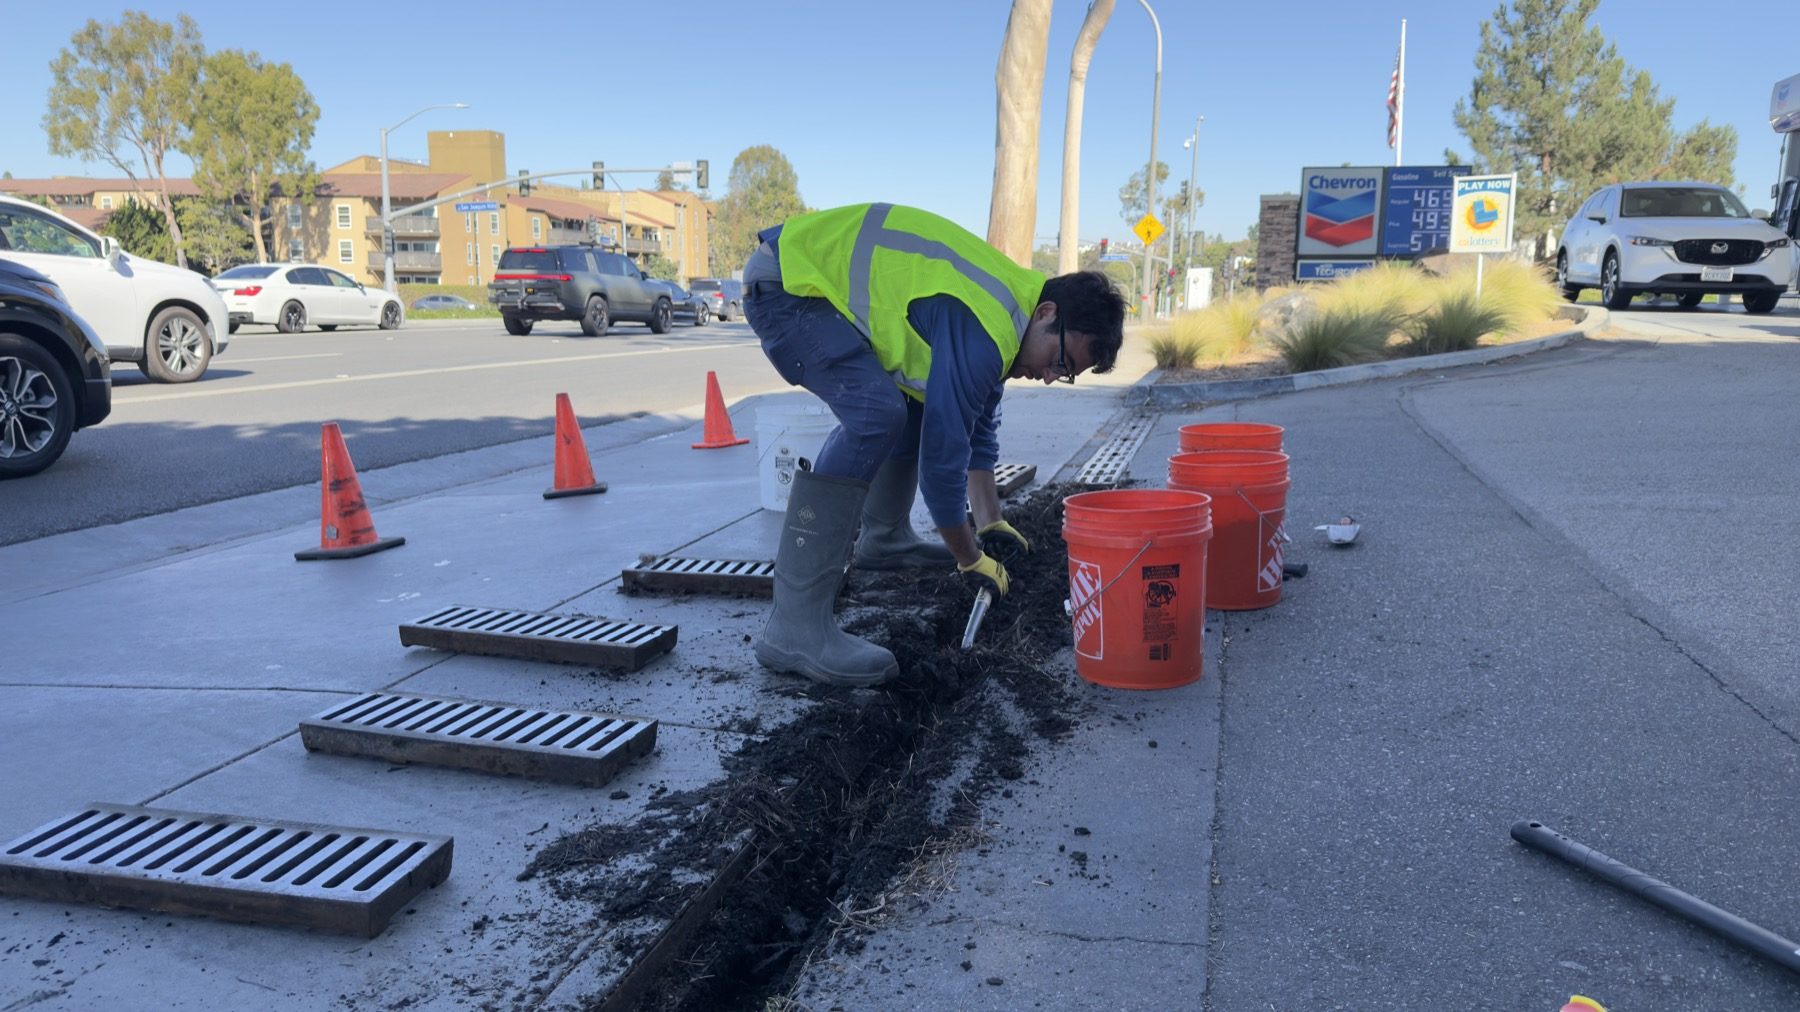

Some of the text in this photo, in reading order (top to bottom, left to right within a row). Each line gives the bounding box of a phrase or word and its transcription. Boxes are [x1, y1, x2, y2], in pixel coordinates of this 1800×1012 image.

[1309, 175, 1377, 189] Chevron
[1458, 180, 1511, 190] PLAY NOW
